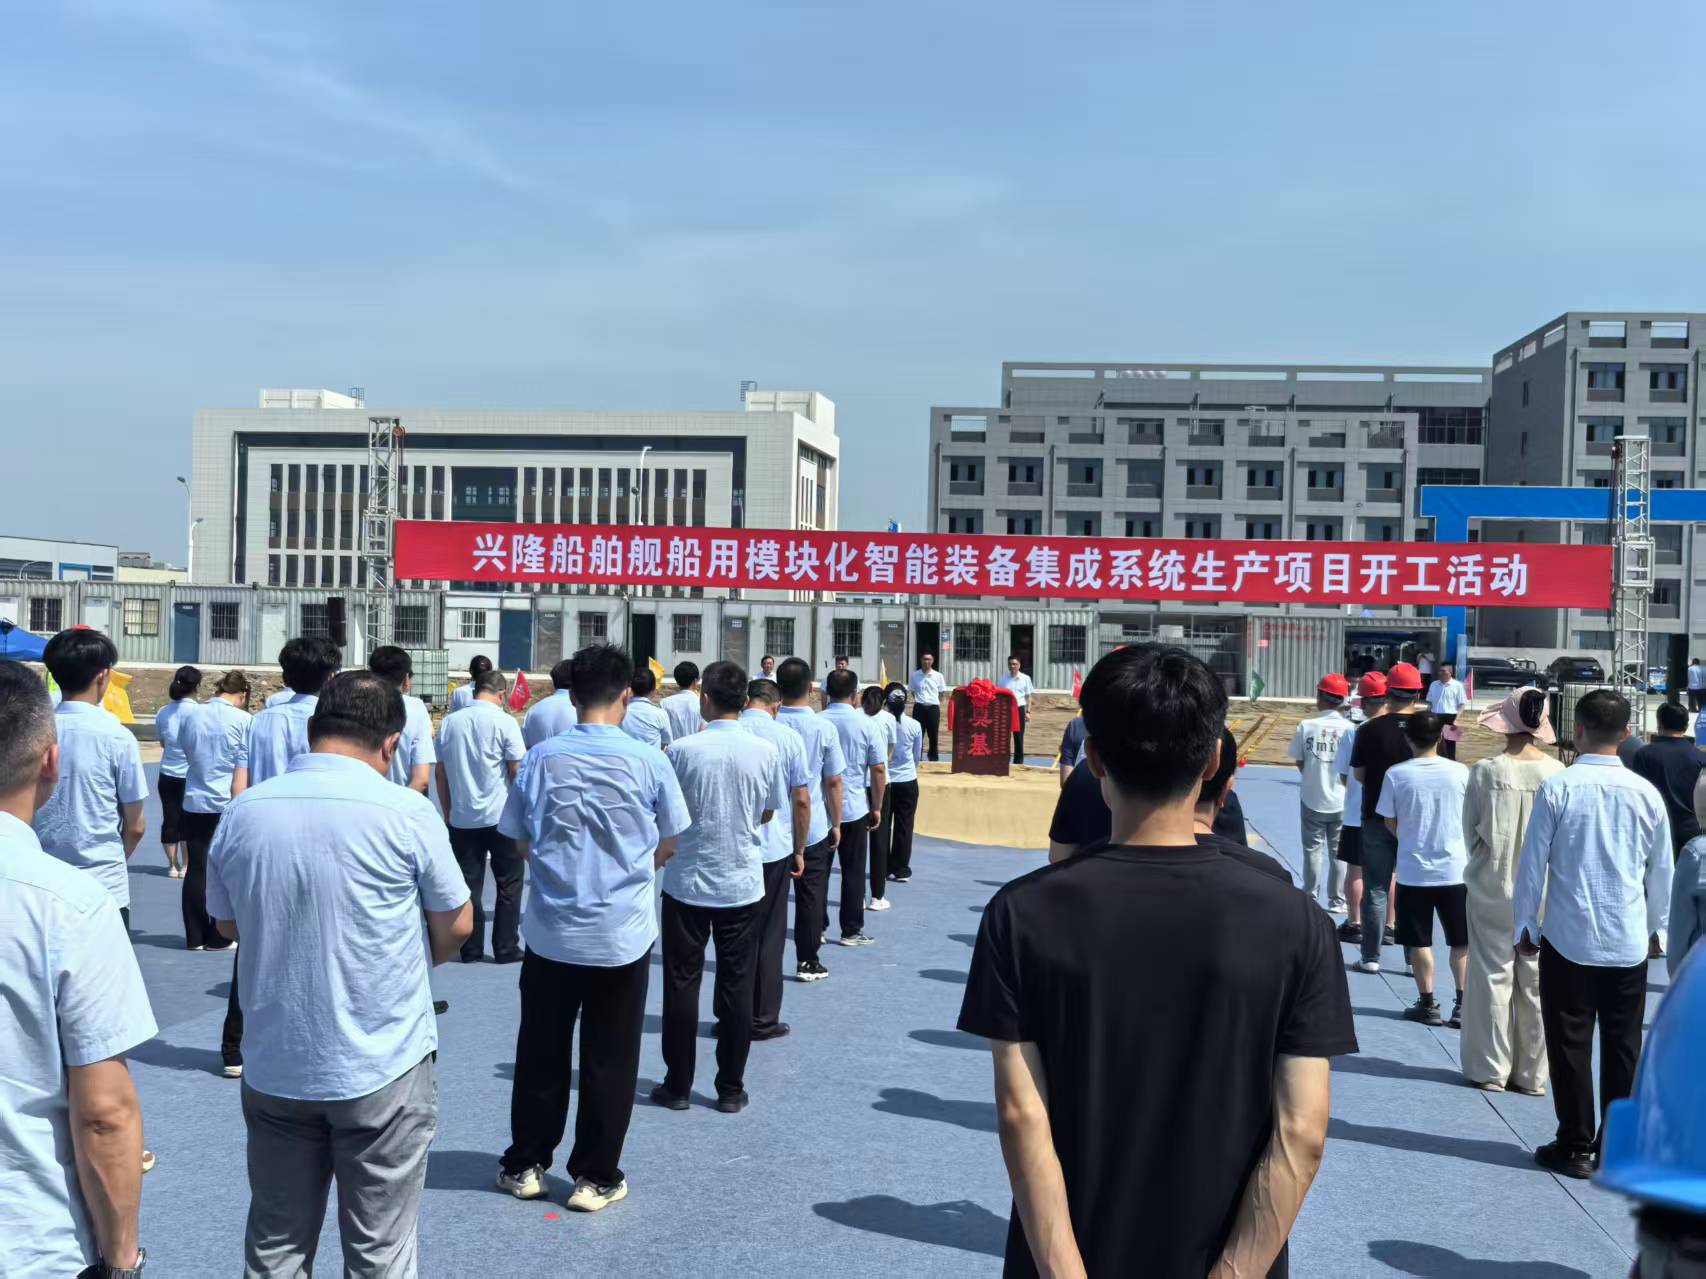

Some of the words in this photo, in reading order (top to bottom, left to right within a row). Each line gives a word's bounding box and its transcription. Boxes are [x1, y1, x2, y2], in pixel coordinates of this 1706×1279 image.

[472, 533, 1528, 597] 兴隆船舶舰船用模块化智能装备集成系统生产项目开工活动
